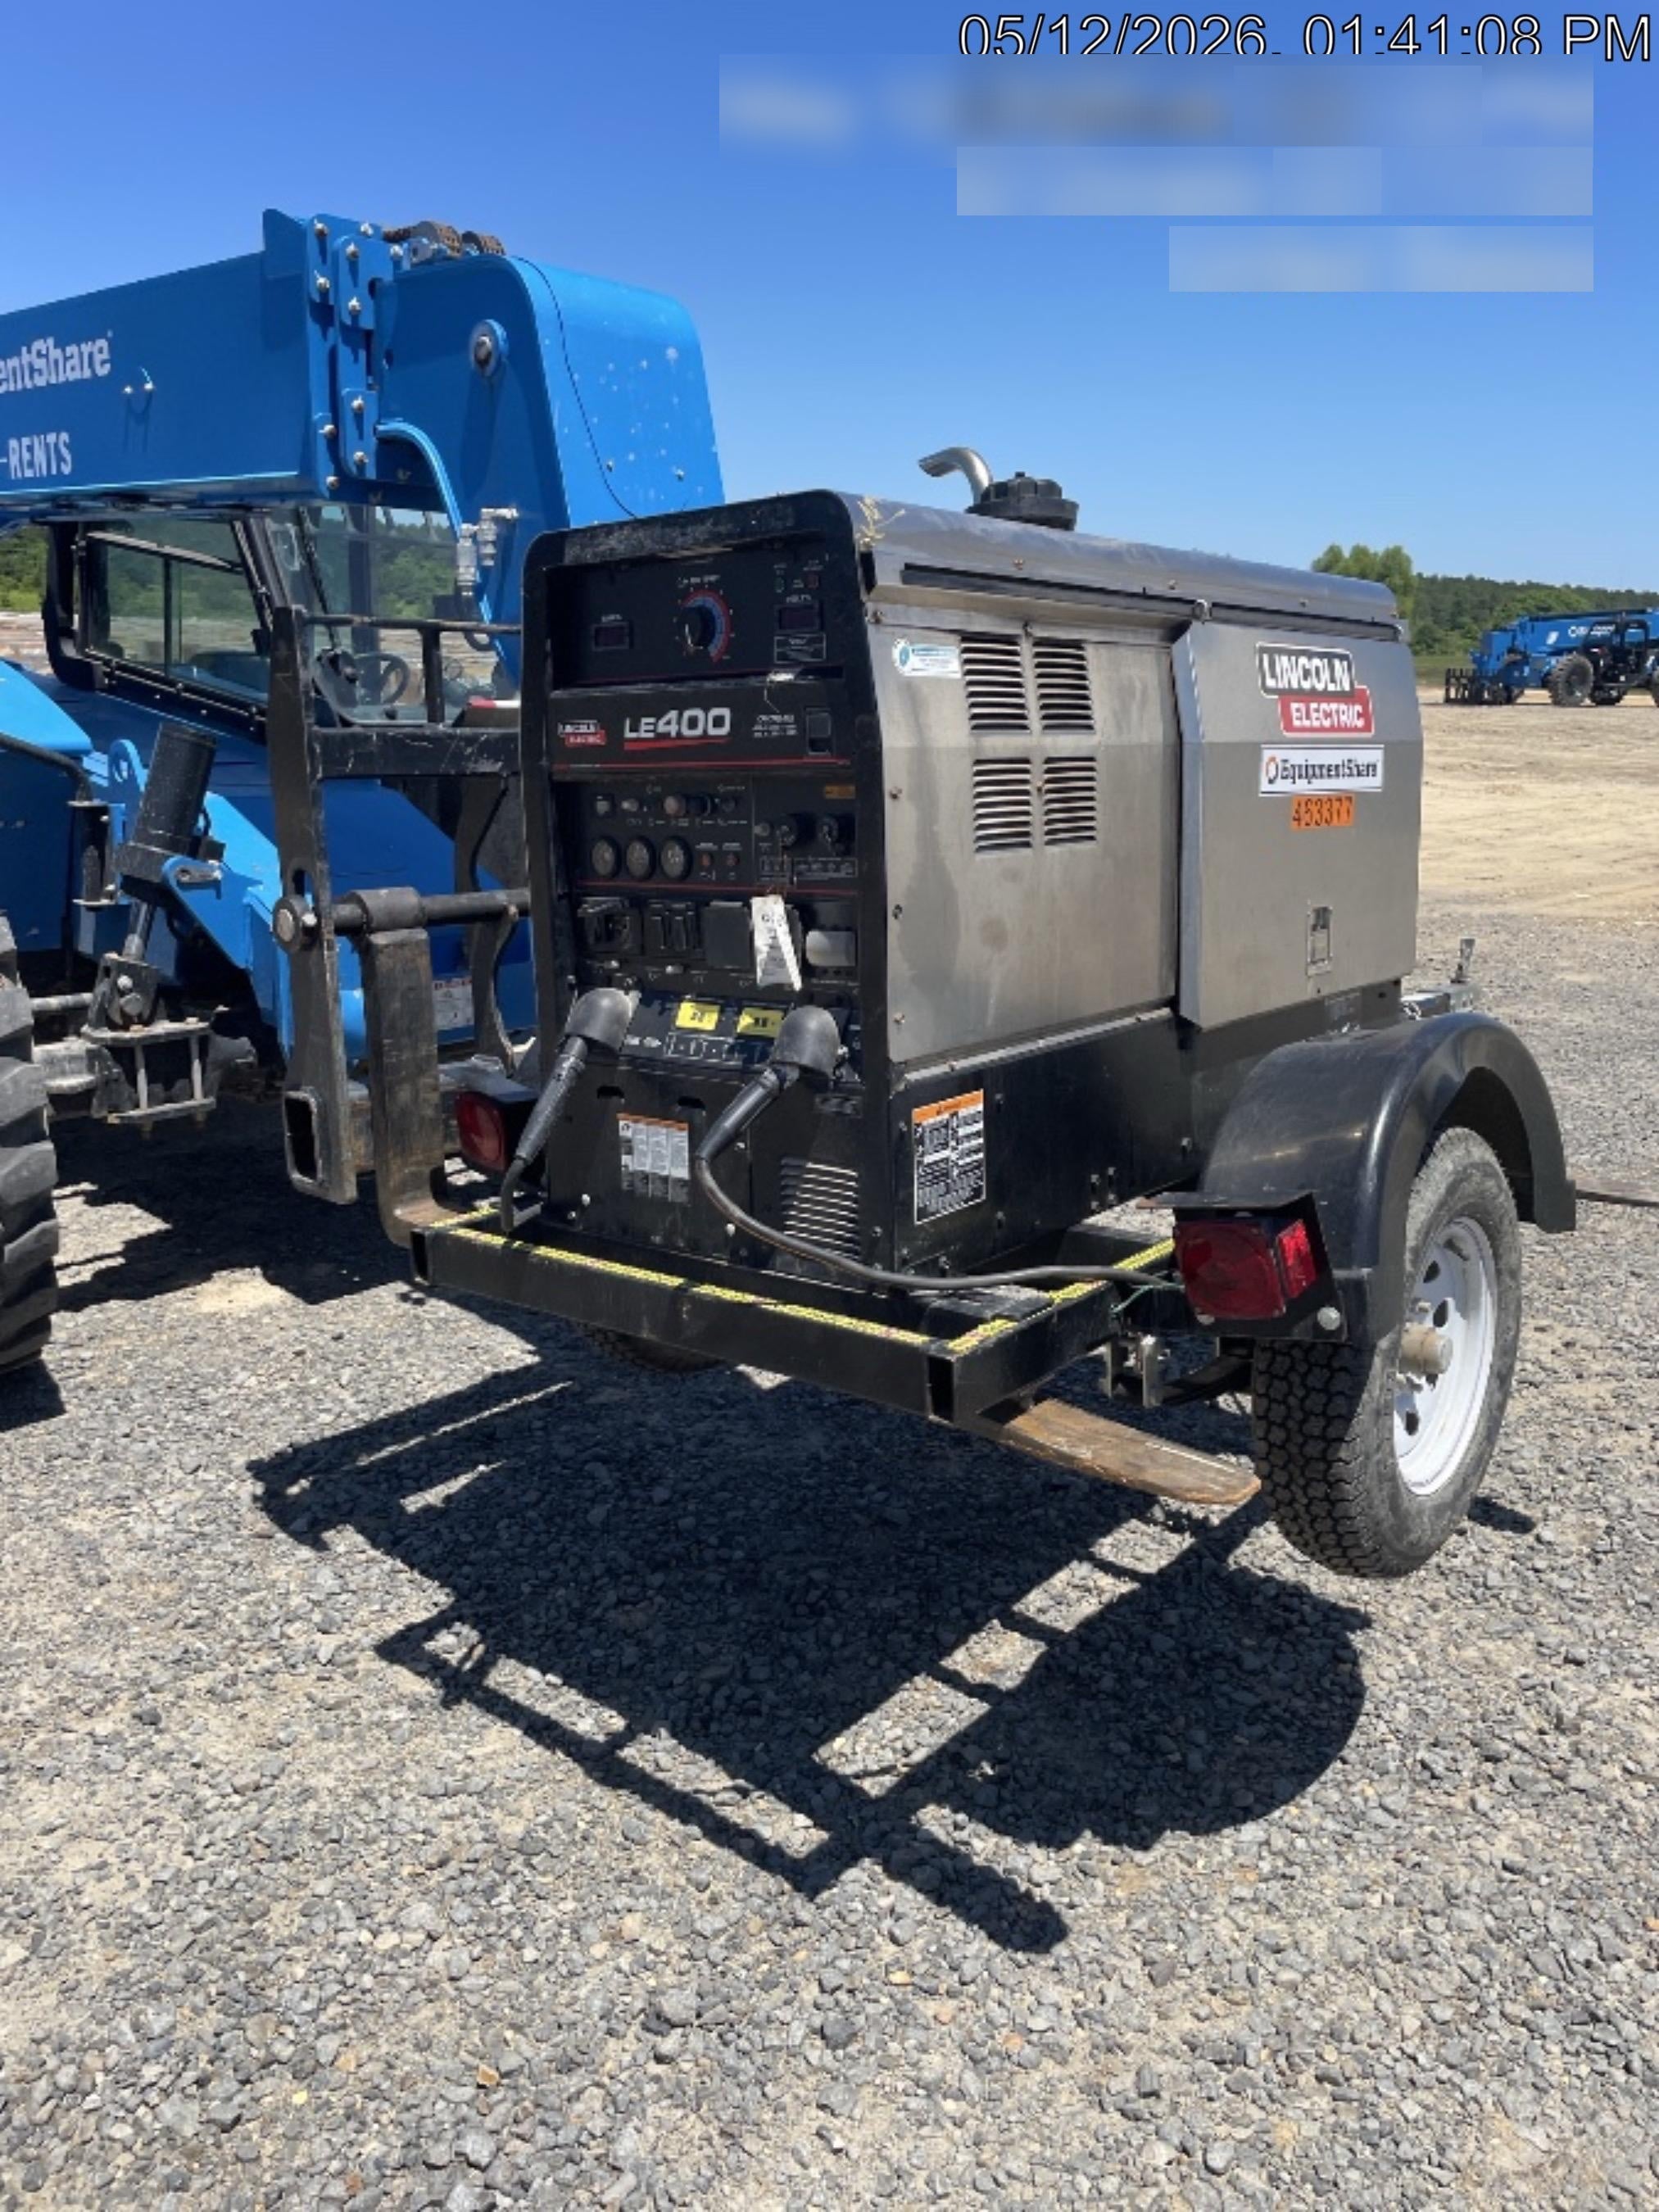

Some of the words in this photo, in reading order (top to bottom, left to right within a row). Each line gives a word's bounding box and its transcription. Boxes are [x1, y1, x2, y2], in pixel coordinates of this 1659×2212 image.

[1262, 653, 1351, 691] LINCOLN
[623, 707, 732, 739] LE400
[1290, 702, 1366, 728] ELECTRIC
[1280, 759, 1379, 785] EquipmentShare
